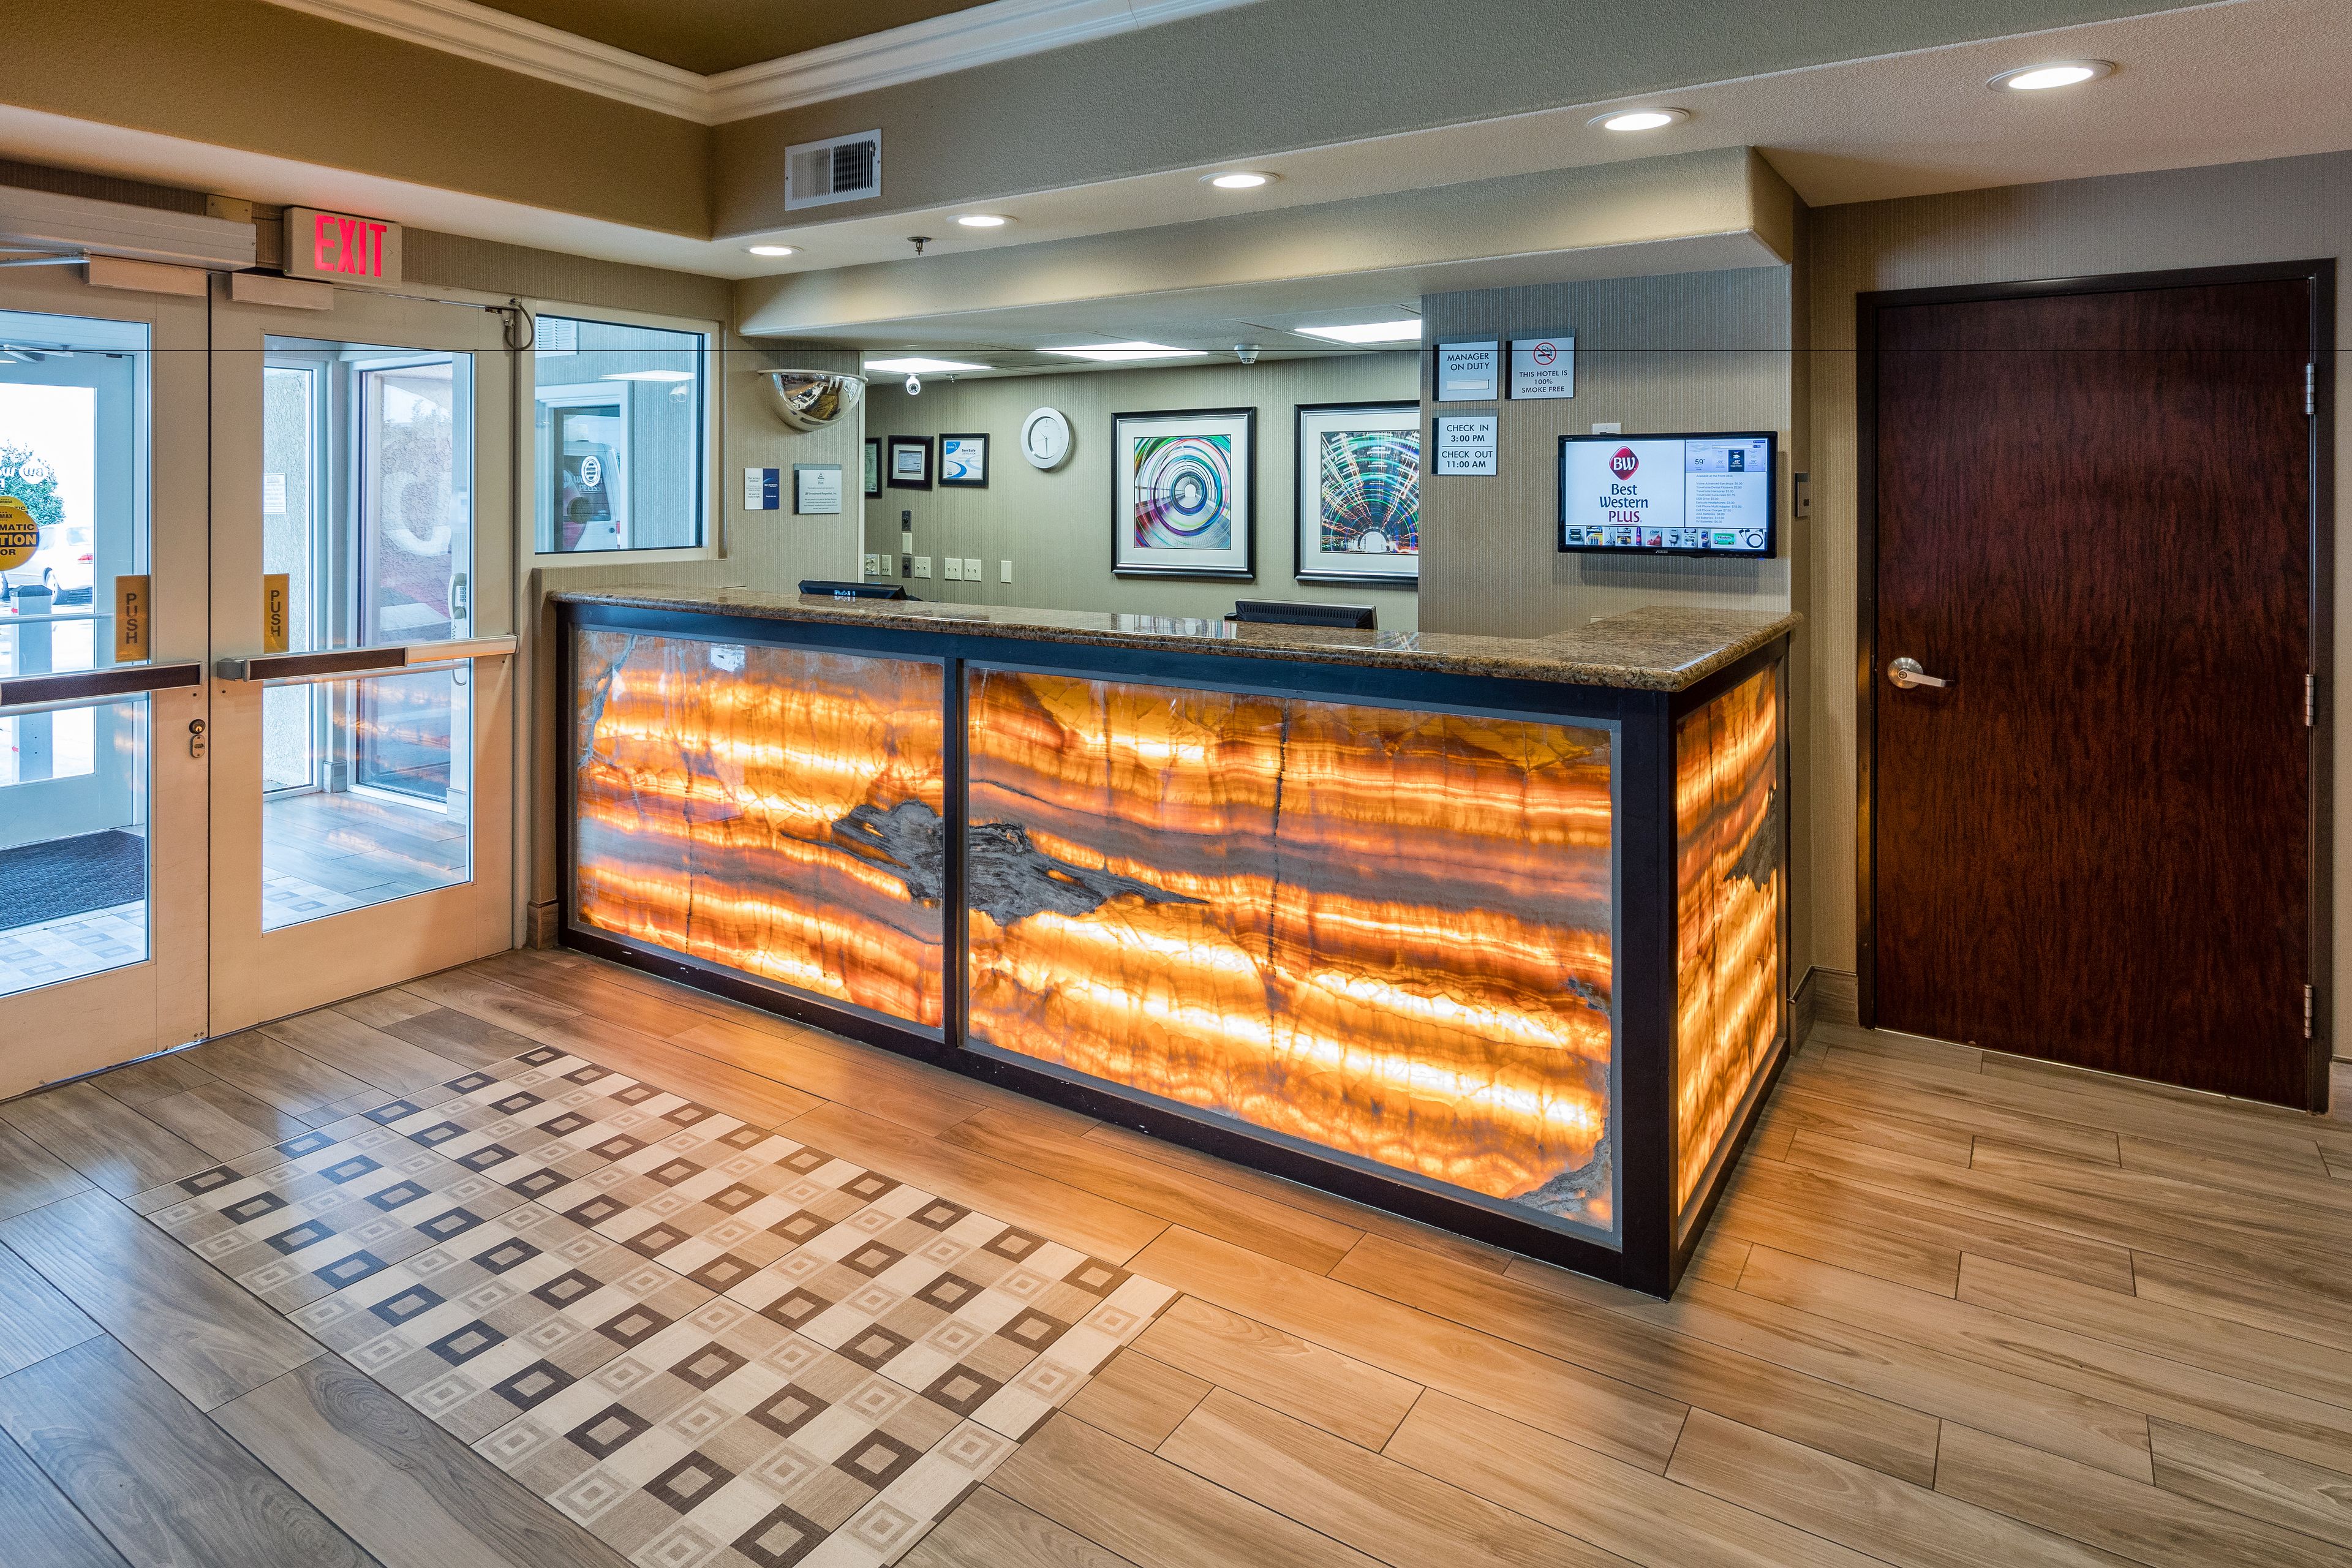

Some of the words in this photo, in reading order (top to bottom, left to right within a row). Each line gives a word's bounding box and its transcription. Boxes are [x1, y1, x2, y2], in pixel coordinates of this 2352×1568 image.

[314, 214, 387, 277] EXIT
[1447, 352, 1489, 361] MANAGER
[1614, 457, 1635, 470] BW
[1611, 484, 1638, 495] Best
[1599, 496, 1648, 508] Western
[1609, 511, 1639, 522] PLUS
[126, 593, 138, 644] PUSH
[270, 590, 281, 637] PUSH
